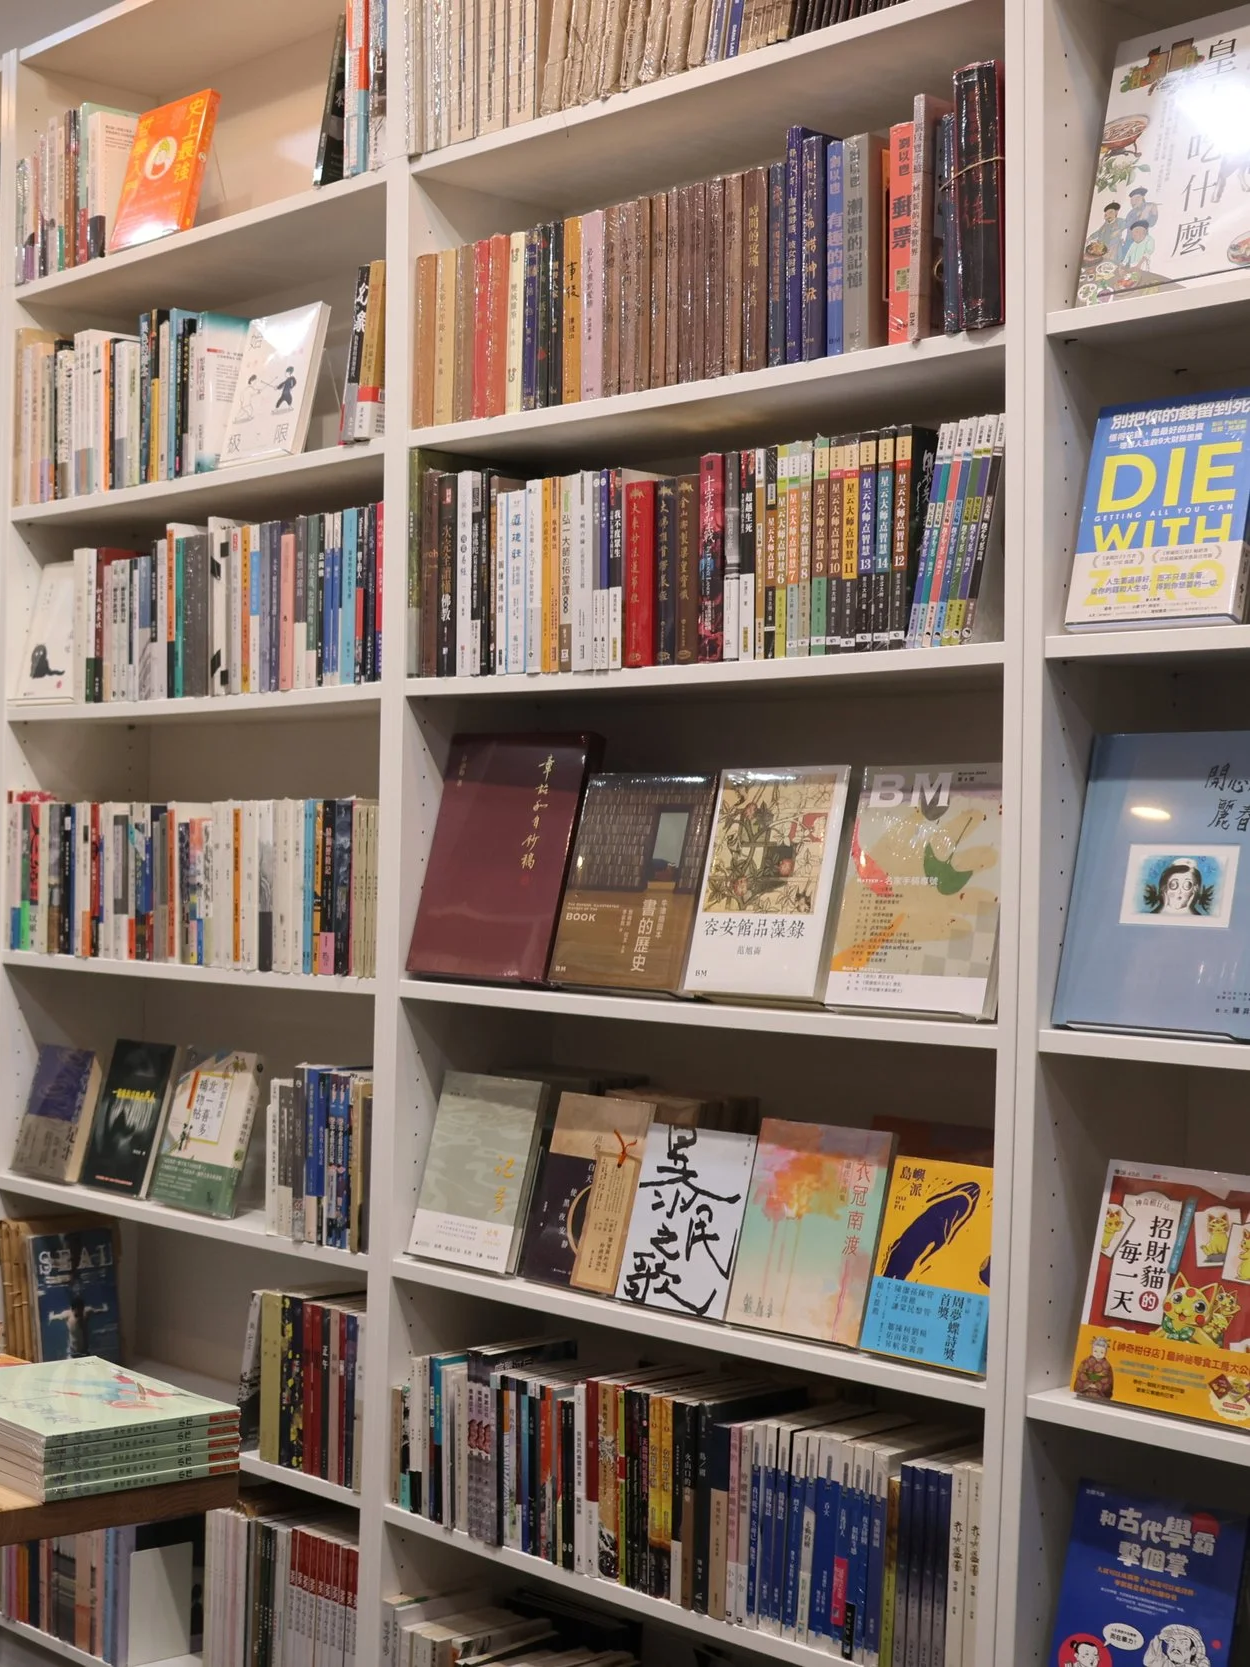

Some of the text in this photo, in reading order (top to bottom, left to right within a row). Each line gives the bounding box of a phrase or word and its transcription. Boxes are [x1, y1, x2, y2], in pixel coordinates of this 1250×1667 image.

[174, 97, 204, 183] 史上最強
[827, 212, 842, 303] 有趣的事情
[566, 261, 580, 298] 事後
[1110, 399, 1250, 430] 別把你的錢留到死
[1097, 441, 1243, 513] DIE
[745, 491, 754, 534] 超越生死
[1093, 513, 1232, 552] WITH
[1094, 503, 1234, 522] GETTING ALL YOU CAN
[1083, 559, 1226, 607] ZERO
[867, 772, 955, 808] BM
[566, 912, 597, 922] BOOK
[630, 898, 658, 972] 書的歷史
[694, 968, 708, 977] BM
[899, 1165, 927, 1183] 島嶼
[842, 1160, 872, 1257] 衣冠南渡
[38, 1243, 113, 1276] SEAL
[1110, 1240, 1142, 1314] 每一天
[1139, 1215, 1174, 1312] 招財貓的
[937, 1293, 952, 1321] 首獎
[943, 1295, 965, 1363] 周夢蝶詩獎
[1099, 1507, 1217, 1556] 和古代學霸
[1117, 1541, 1189, 1578] 擊個掌
